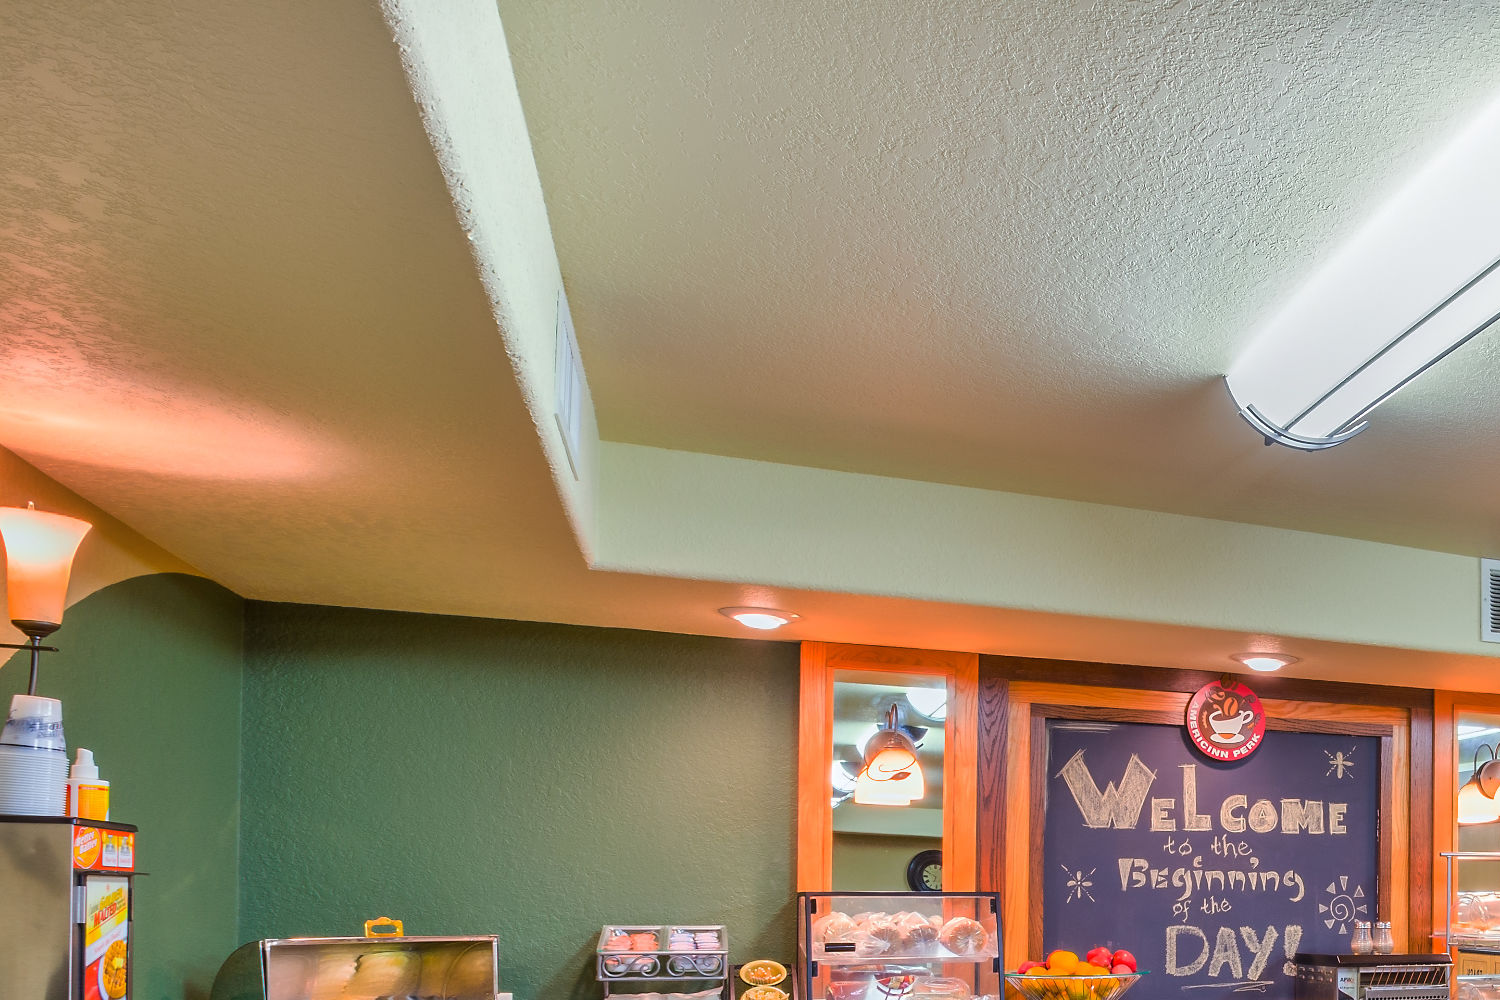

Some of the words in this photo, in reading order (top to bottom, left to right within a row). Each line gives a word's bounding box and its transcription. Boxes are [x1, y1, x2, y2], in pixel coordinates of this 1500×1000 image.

[1189, 701, 1229, 758] AMERICINN
[1232, 733, 1261, 758] PERK
[1055, 748, 1348, 835] WELCOME
[1163, 835, 1192, 856] to
[1210, 834, 1252, 858] the
[1172, 900, 1192, 923] of
[1200, 896, 1232, 915] the
[1165, 925, 1303, 981] DAY!
